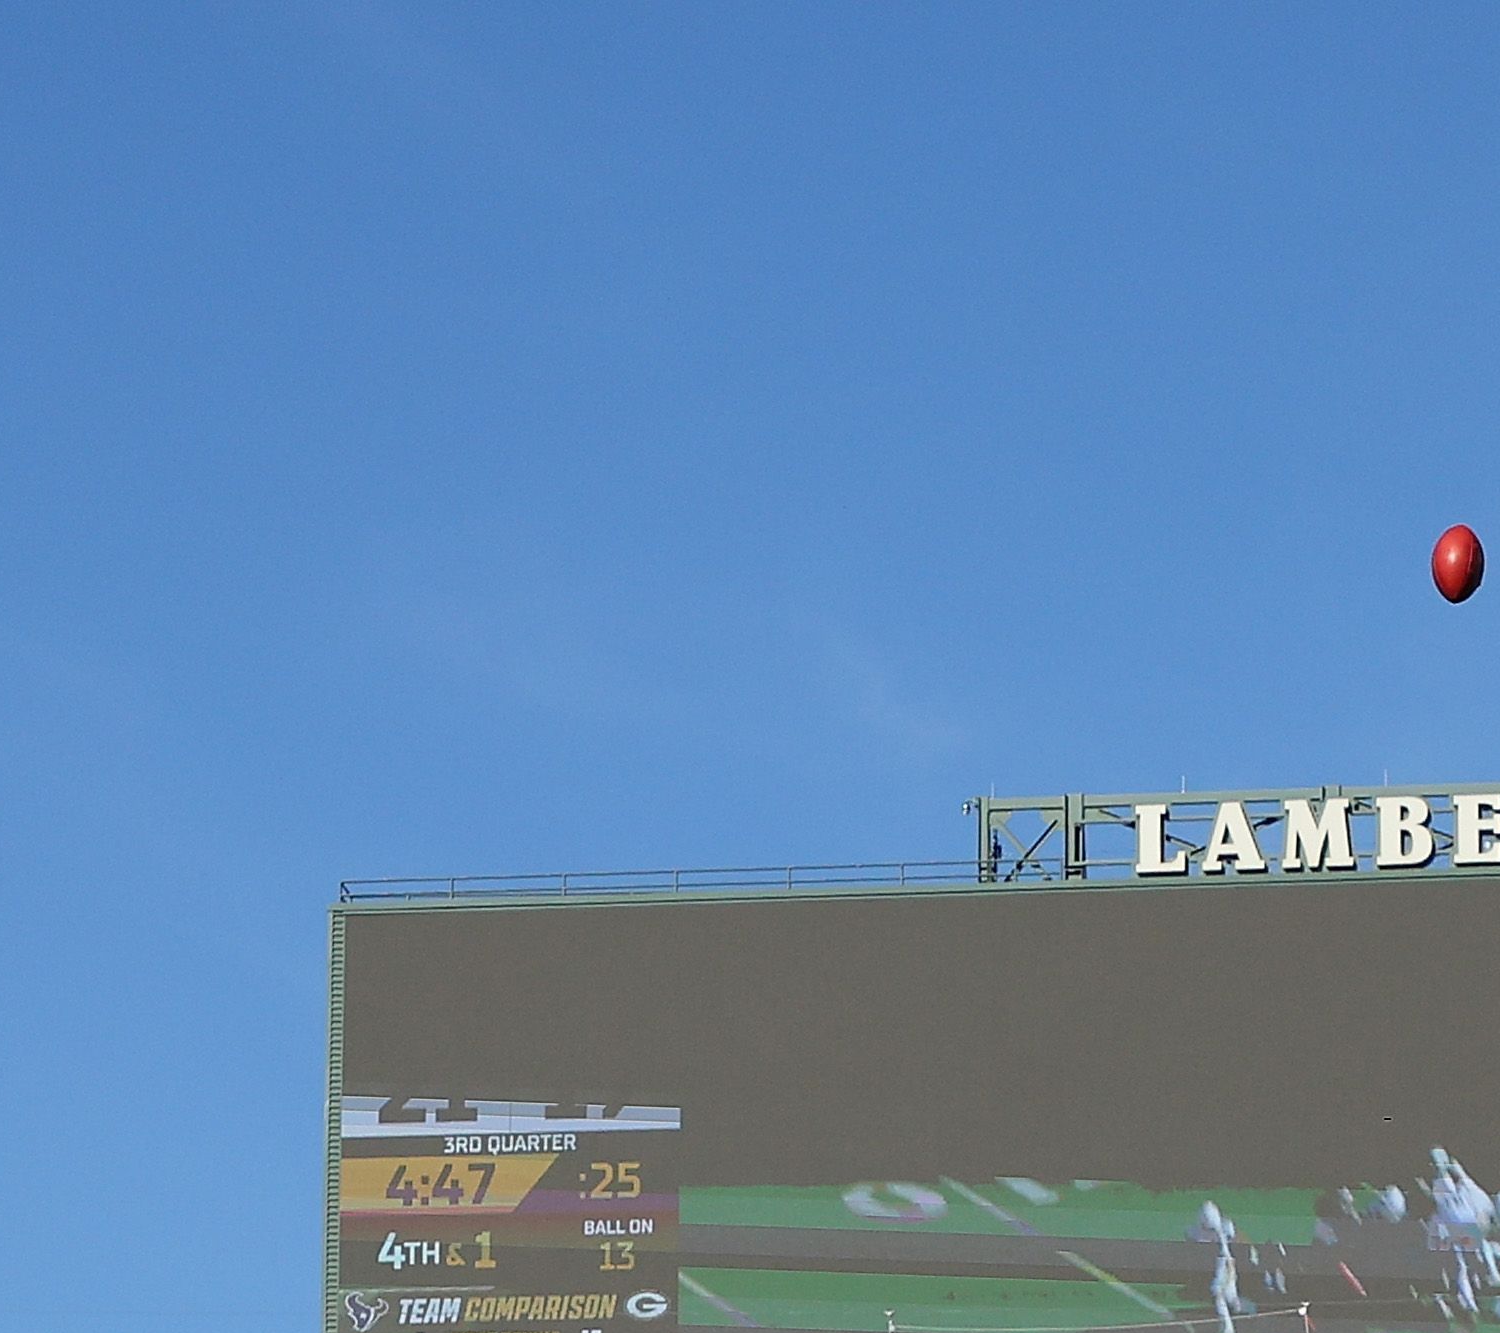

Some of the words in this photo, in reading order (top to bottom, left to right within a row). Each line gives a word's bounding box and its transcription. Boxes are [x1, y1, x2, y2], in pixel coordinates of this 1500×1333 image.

[443, 1136, 482, 1155] 3RD
[487, 1133, 577, 1155] QUARTER
[385, 1163, 497, 1207] 4:47
[583, 1219, 626, 1236] BALL
[629, 1218, 654, 1234] ON
[377, 1231, 441, 1270] 4TH
[445, 1242, 467, 1267] &
[474, 1230, 498, 1270] 1
[599, 1241, 636, 1271] 13
[398, 1297, 462, 1325] TEAM
[463, 1294, 618, 1322] COMPARISON
